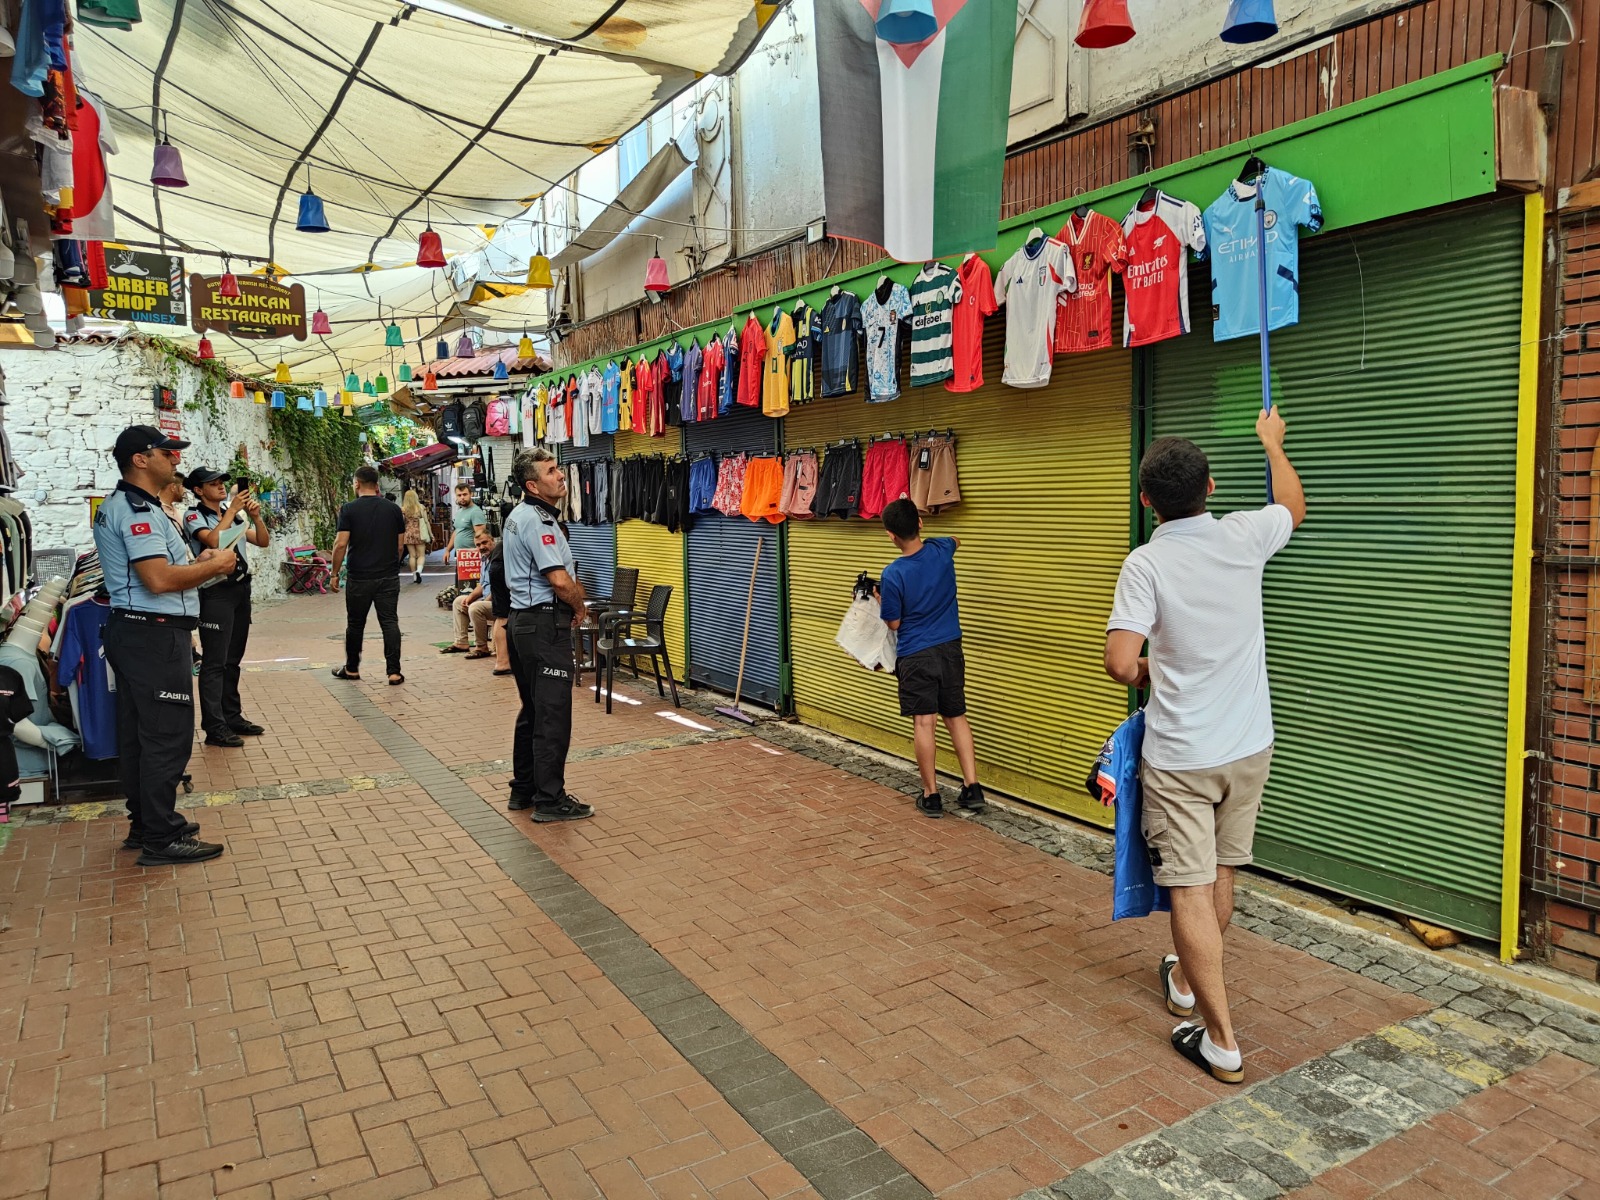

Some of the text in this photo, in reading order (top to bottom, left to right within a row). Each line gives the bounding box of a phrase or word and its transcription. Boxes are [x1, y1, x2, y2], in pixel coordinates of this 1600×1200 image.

[1127, 255, 1168, 279] Emirates
[107, 276, 169, 297] ARBER
[102, 292, 157, 311] SHOP
[131, 311, 177, 324] UNISEX
[200, 307, 302, 326] RESTAURANT
[914, 313, 942, 328] dafabet
[877, 326, 886, 349] 7
[460, 551, 482, 560] ERZ
[124, 613, 147, 621] ZABITA
[543, 666, 569, 678] ZABITA
[158, 690, 190, 702] ZABITA
